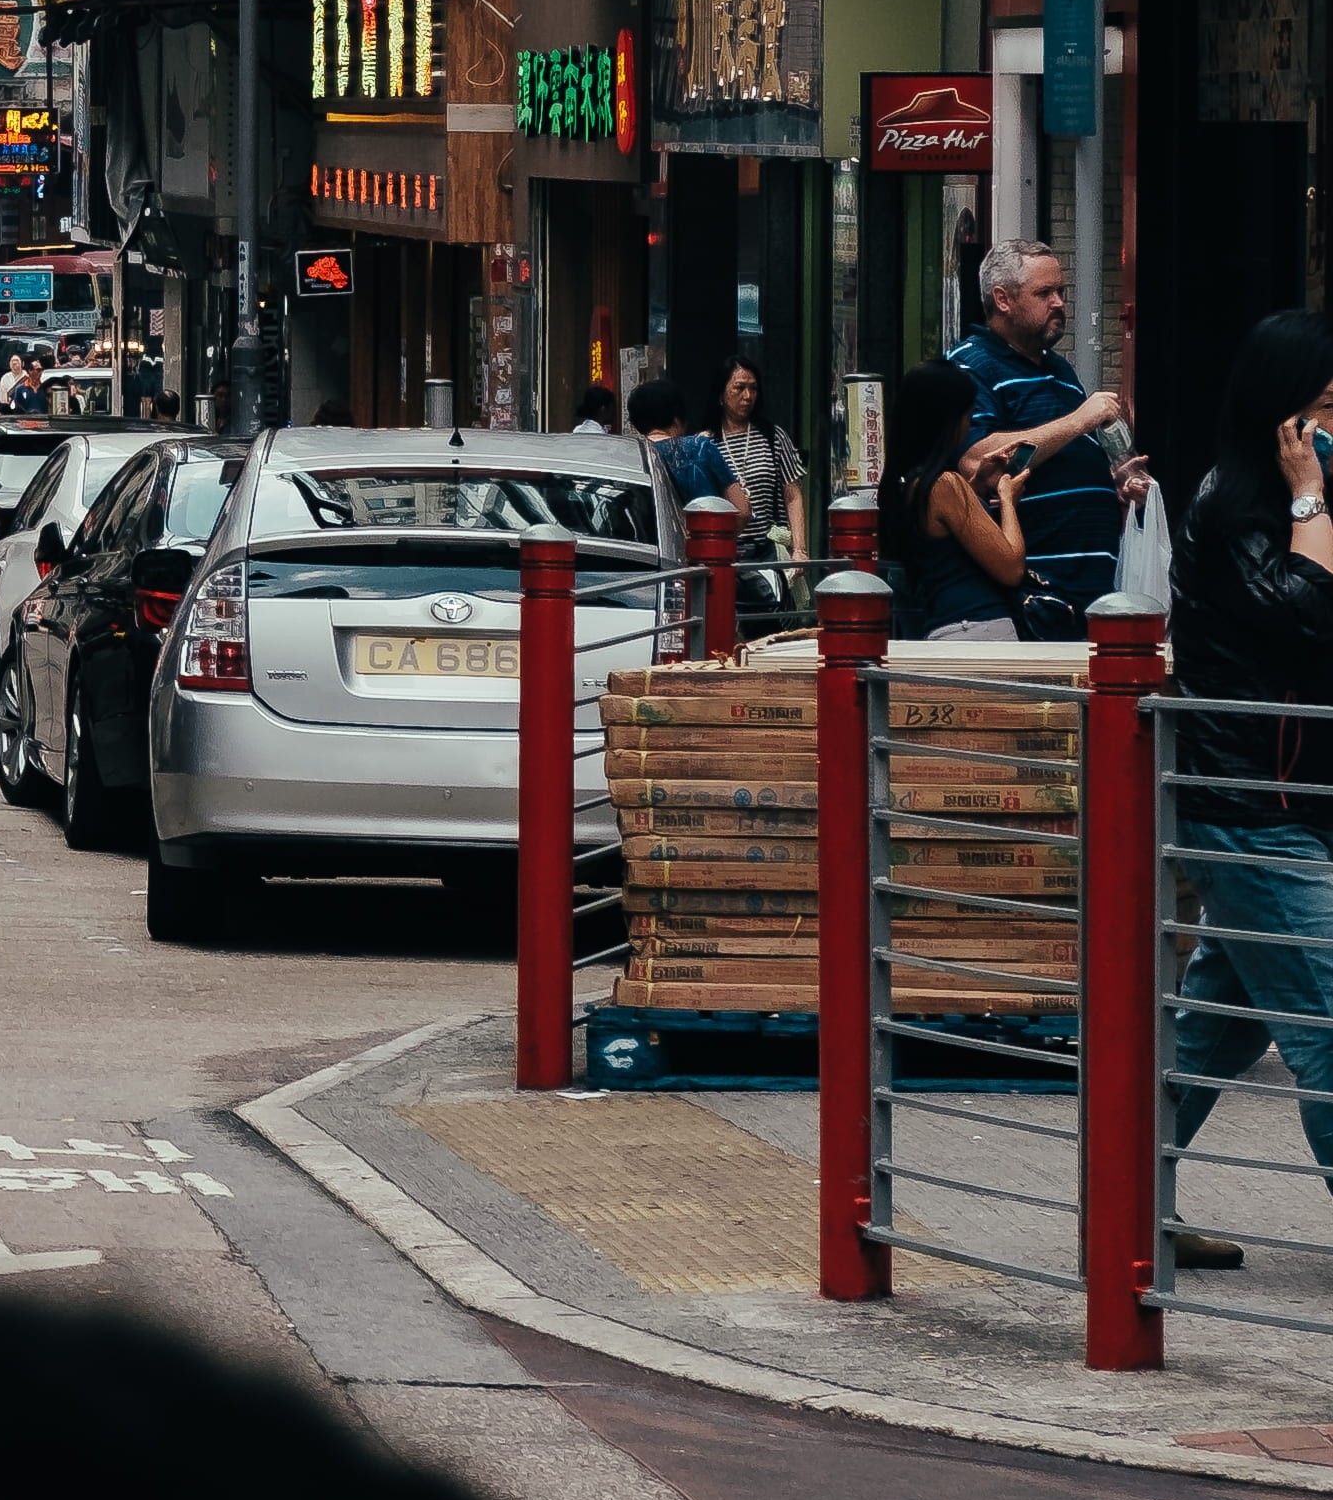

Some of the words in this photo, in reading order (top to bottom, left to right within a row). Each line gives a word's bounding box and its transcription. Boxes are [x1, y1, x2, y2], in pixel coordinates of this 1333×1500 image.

[878, 129, 940, 151] Pizza
[943, 129, 989, 149] Hut
[369, 642, 420, 672] CA
[905, 704, 924, 726] B
[929, 704, 955, 725] 38
